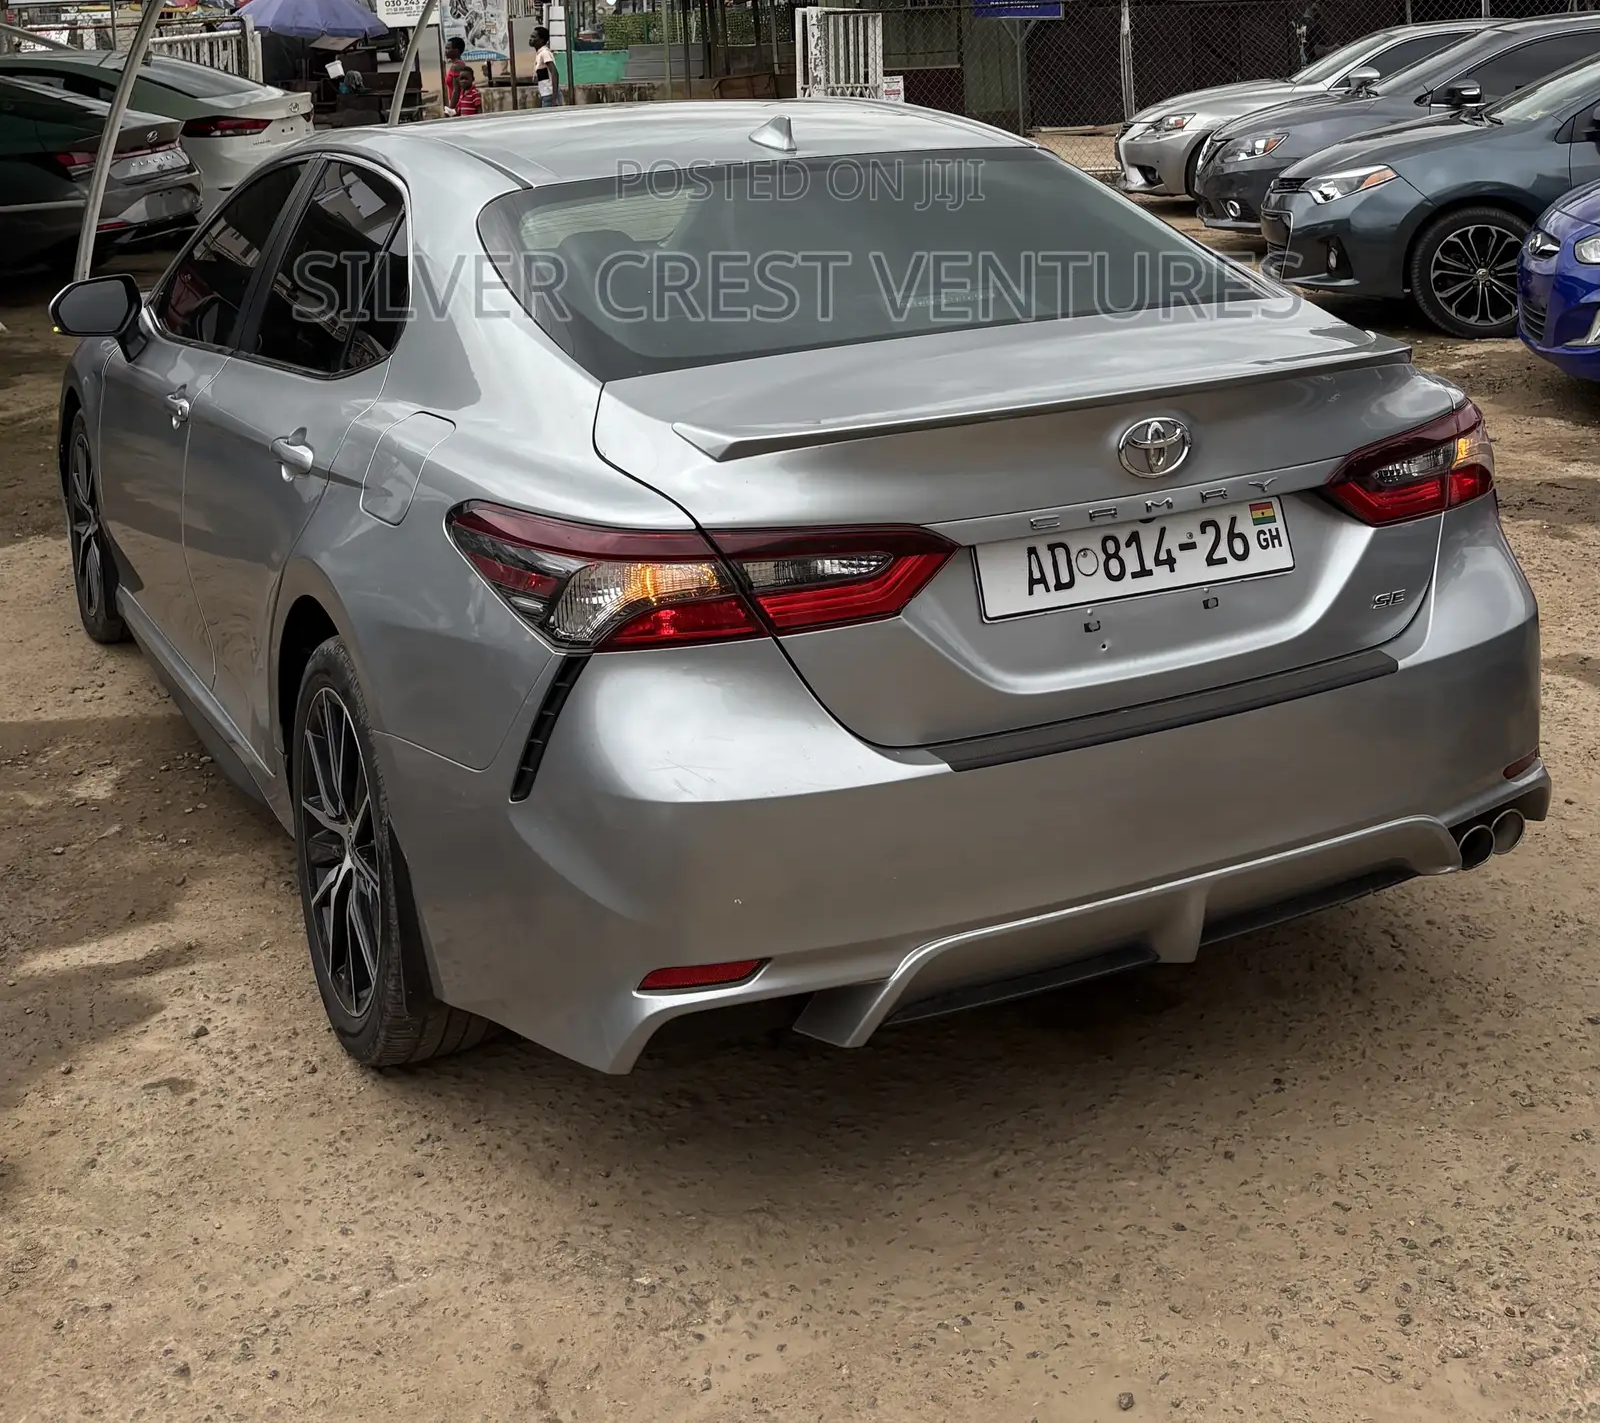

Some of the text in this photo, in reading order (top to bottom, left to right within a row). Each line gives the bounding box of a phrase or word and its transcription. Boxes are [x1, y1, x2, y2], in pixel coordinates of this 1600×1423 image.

[1030, 477, 1279, 530] CAMRY
[1027, 542, 1075, 596] AD
[1256, 527, 1283, 551] GH
[1372, 588, 1406, 609] SE
